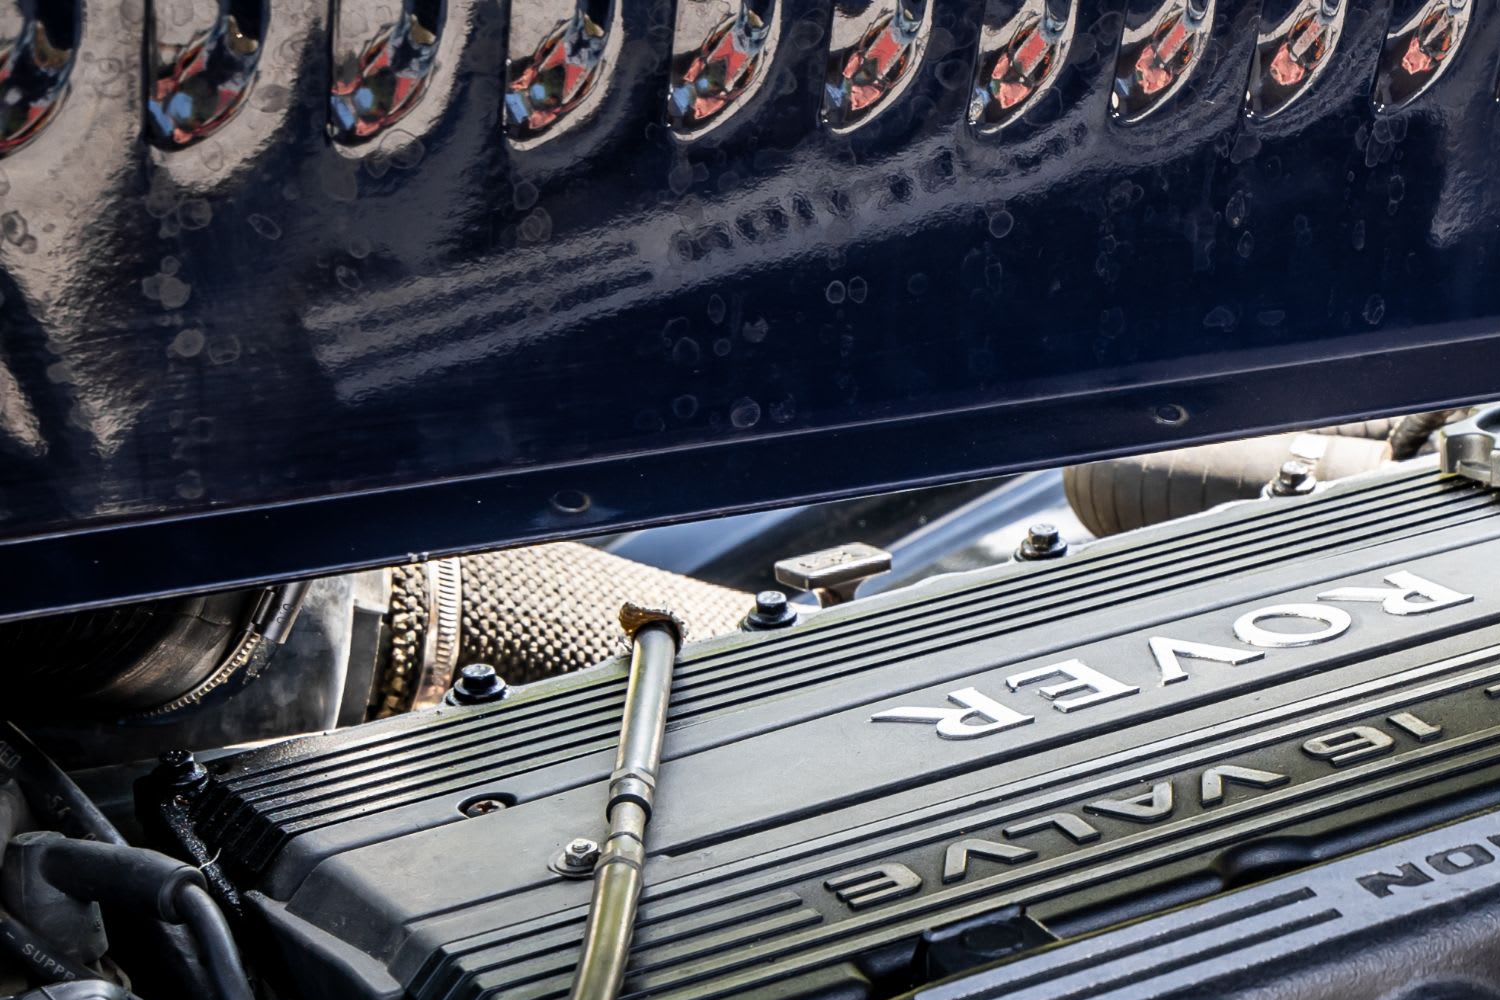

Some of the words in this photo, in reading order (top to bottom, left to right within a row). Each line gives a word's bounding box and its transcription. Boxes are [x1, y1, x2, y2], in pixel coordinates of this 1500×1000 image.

[869, 570, 1475, 741] ROVER
[1302, 712, 1444, 768] 16
[823, 764, 1290, 910] VALVE
